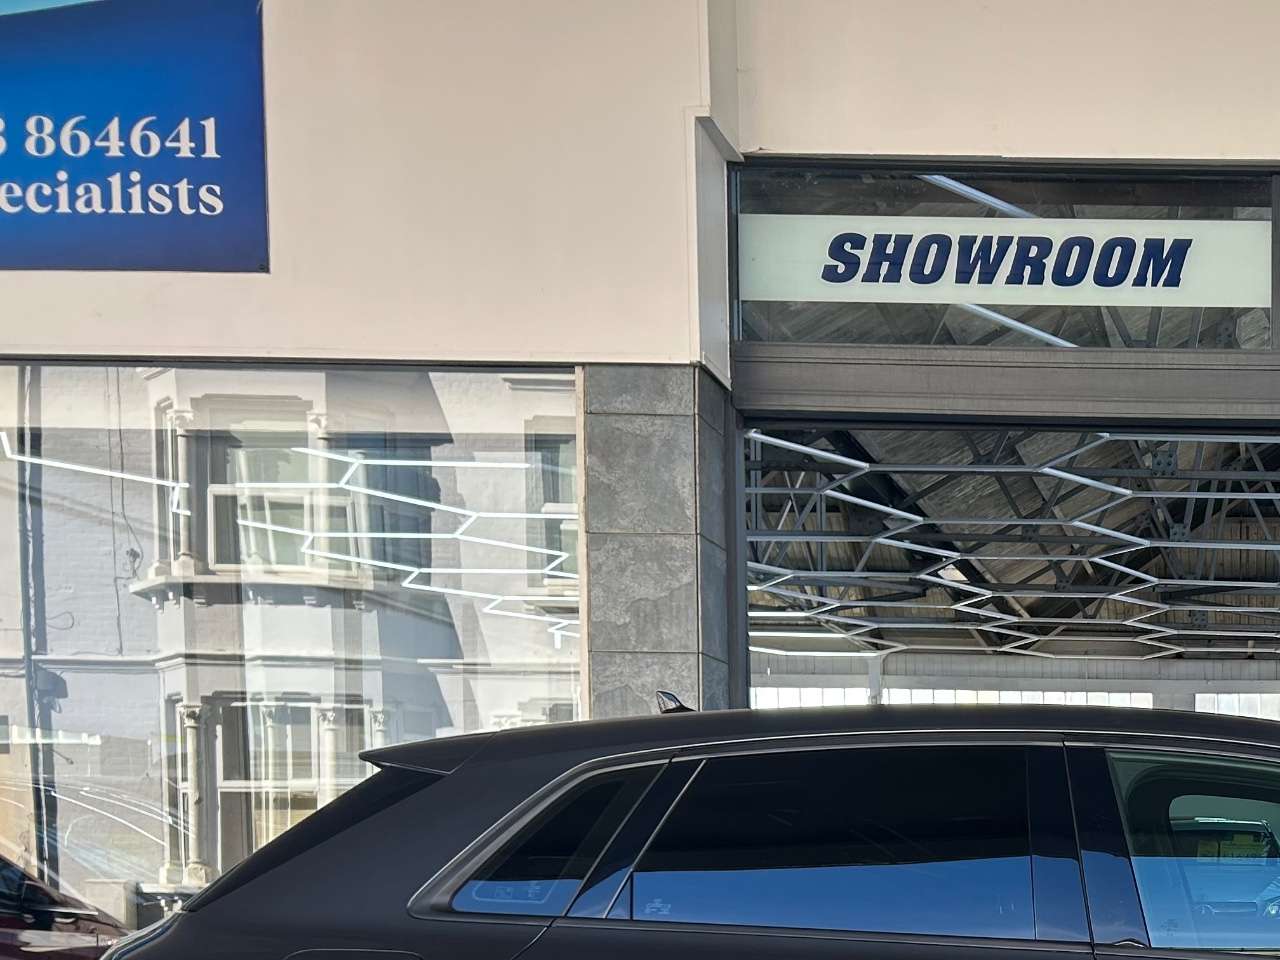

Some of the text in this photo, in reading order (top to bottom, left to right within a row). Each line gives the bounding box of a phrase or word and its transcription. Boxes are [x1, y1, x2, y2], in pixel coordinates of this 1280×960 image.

[25, 115, 222, 159] 864641
[0, 170, 225, 216] ecialists
[820, 232, 1194, 289] SHOWROOM
